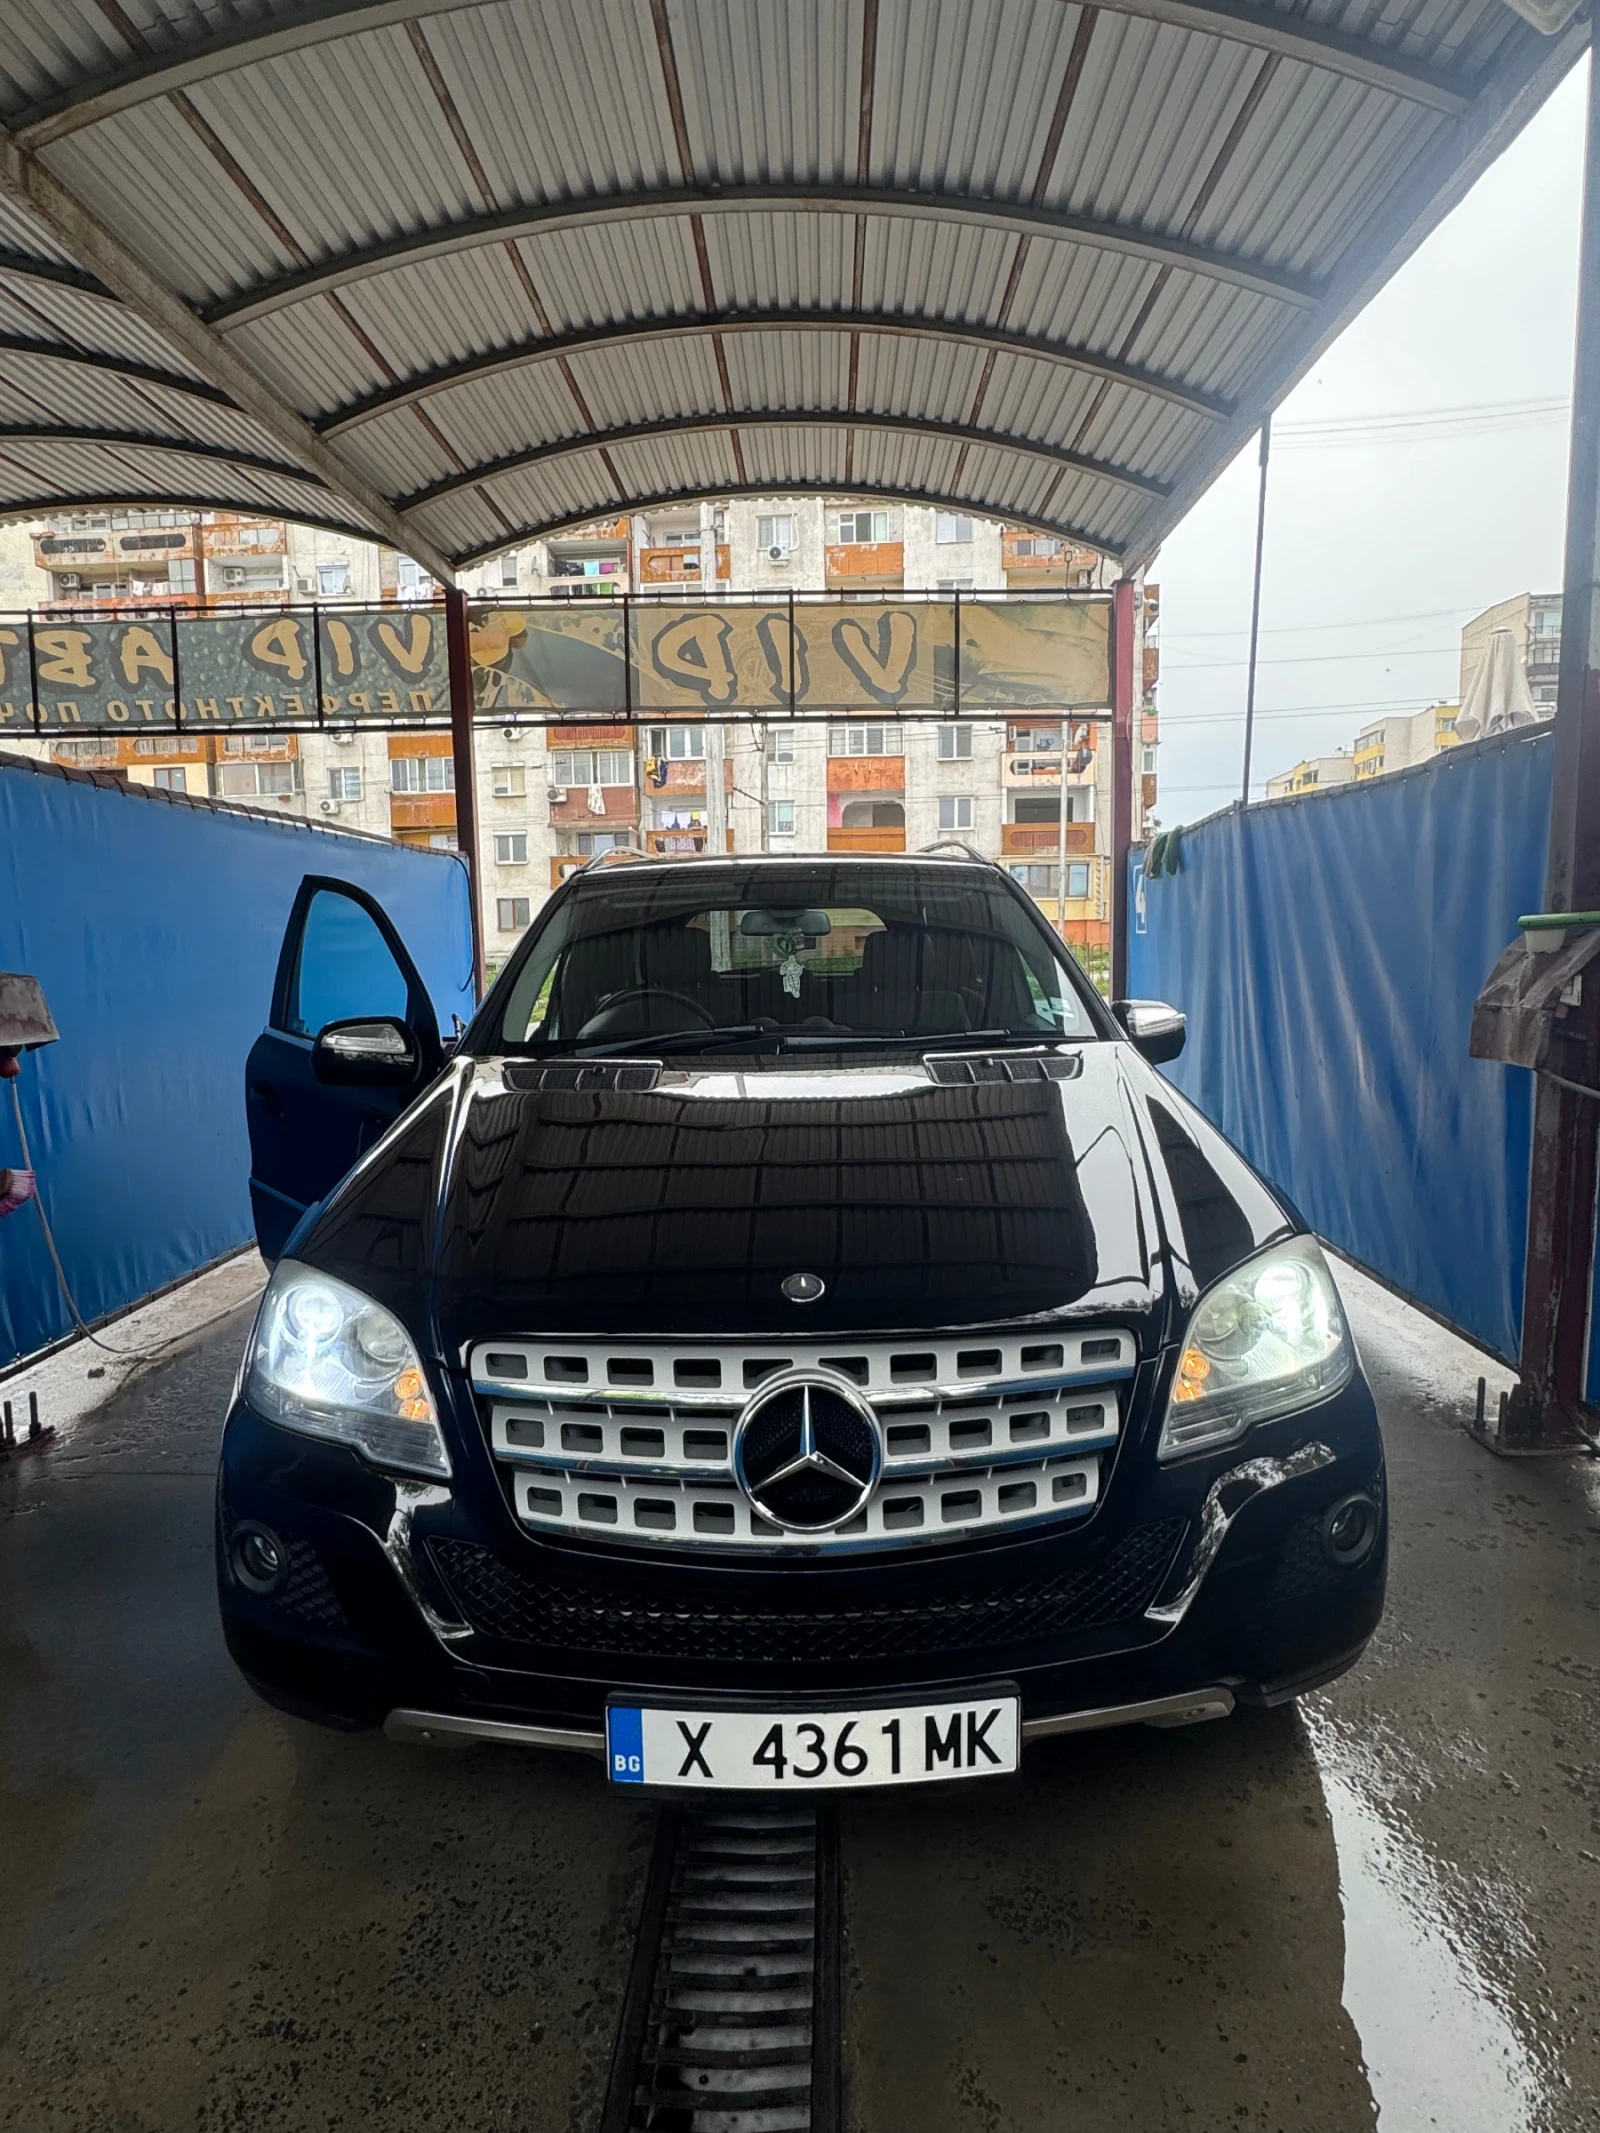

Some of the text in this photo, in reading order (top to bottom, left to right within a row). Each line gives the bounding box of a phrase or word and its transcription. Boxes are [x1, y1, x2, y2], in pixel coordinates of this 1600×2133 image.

[614, 1753, 641, 1774] BG
[675, 1707, 1003, 1781] X 4361 MK
